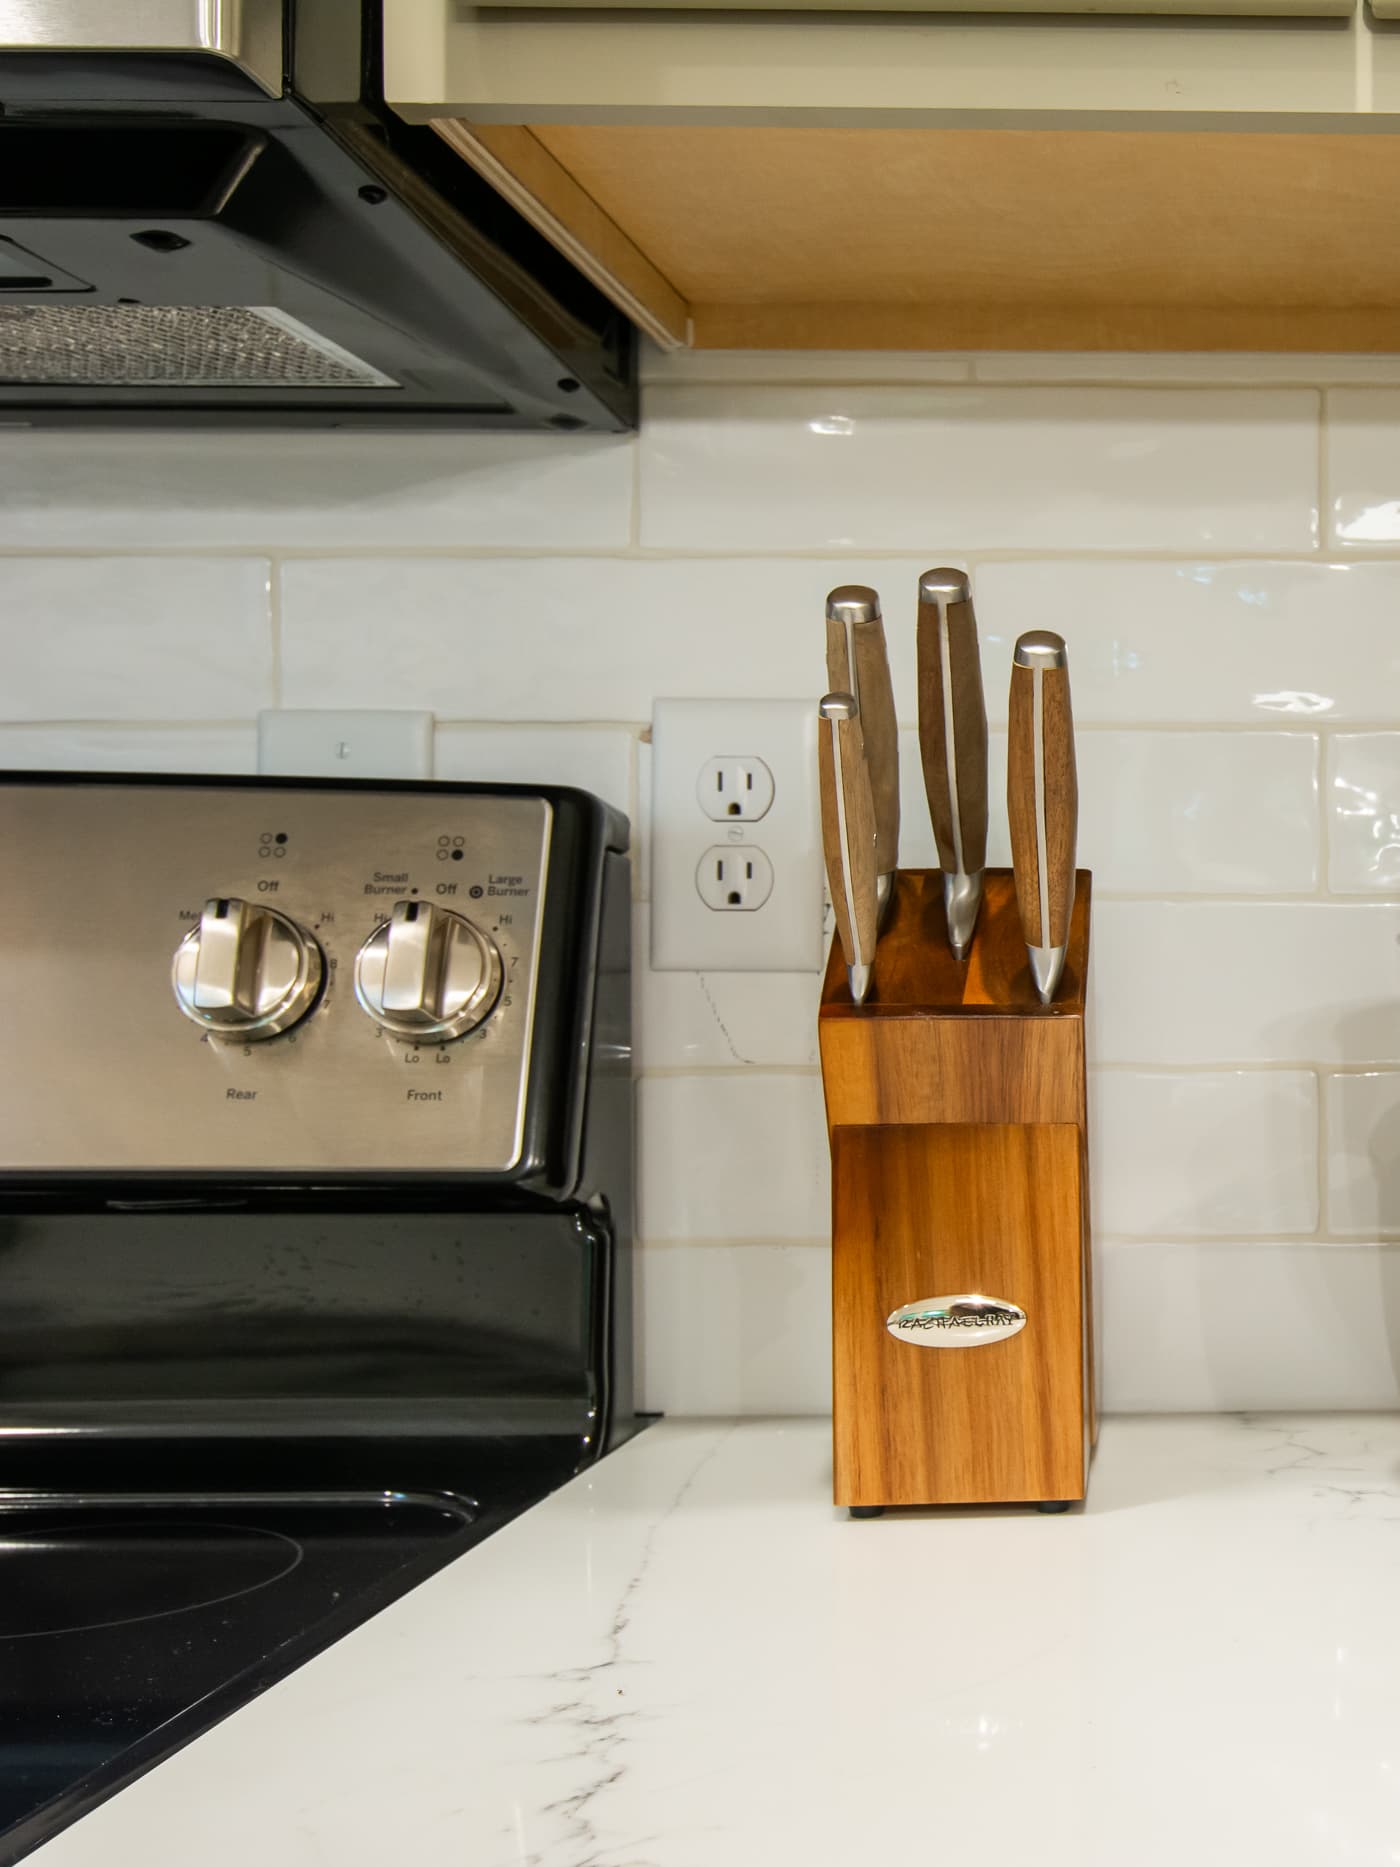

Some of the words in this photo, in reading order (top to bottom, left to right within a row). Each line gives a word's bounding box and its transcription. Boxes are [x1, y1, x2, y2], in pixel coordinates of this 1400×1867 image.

[373, 872, 409, 882] Small
[488, 874, 523, 886] Large
[257, 880, 280, 892] Off
[364, 884, 407, 895] Burner
[436, 883, 458, 895] Off
[487, 886, 530, 897] Burner
[321, 912, 335, 922] Hi
[499, 914, 513, 925] Hi
[511, 957, 519, 967] 7
[405, 1053, 420, 1064] Lo
[436, 1053, 451, 1064] Lo
[226, 1088, 258, 1100] Rear
[407, 1089, 443, 1101] Front
